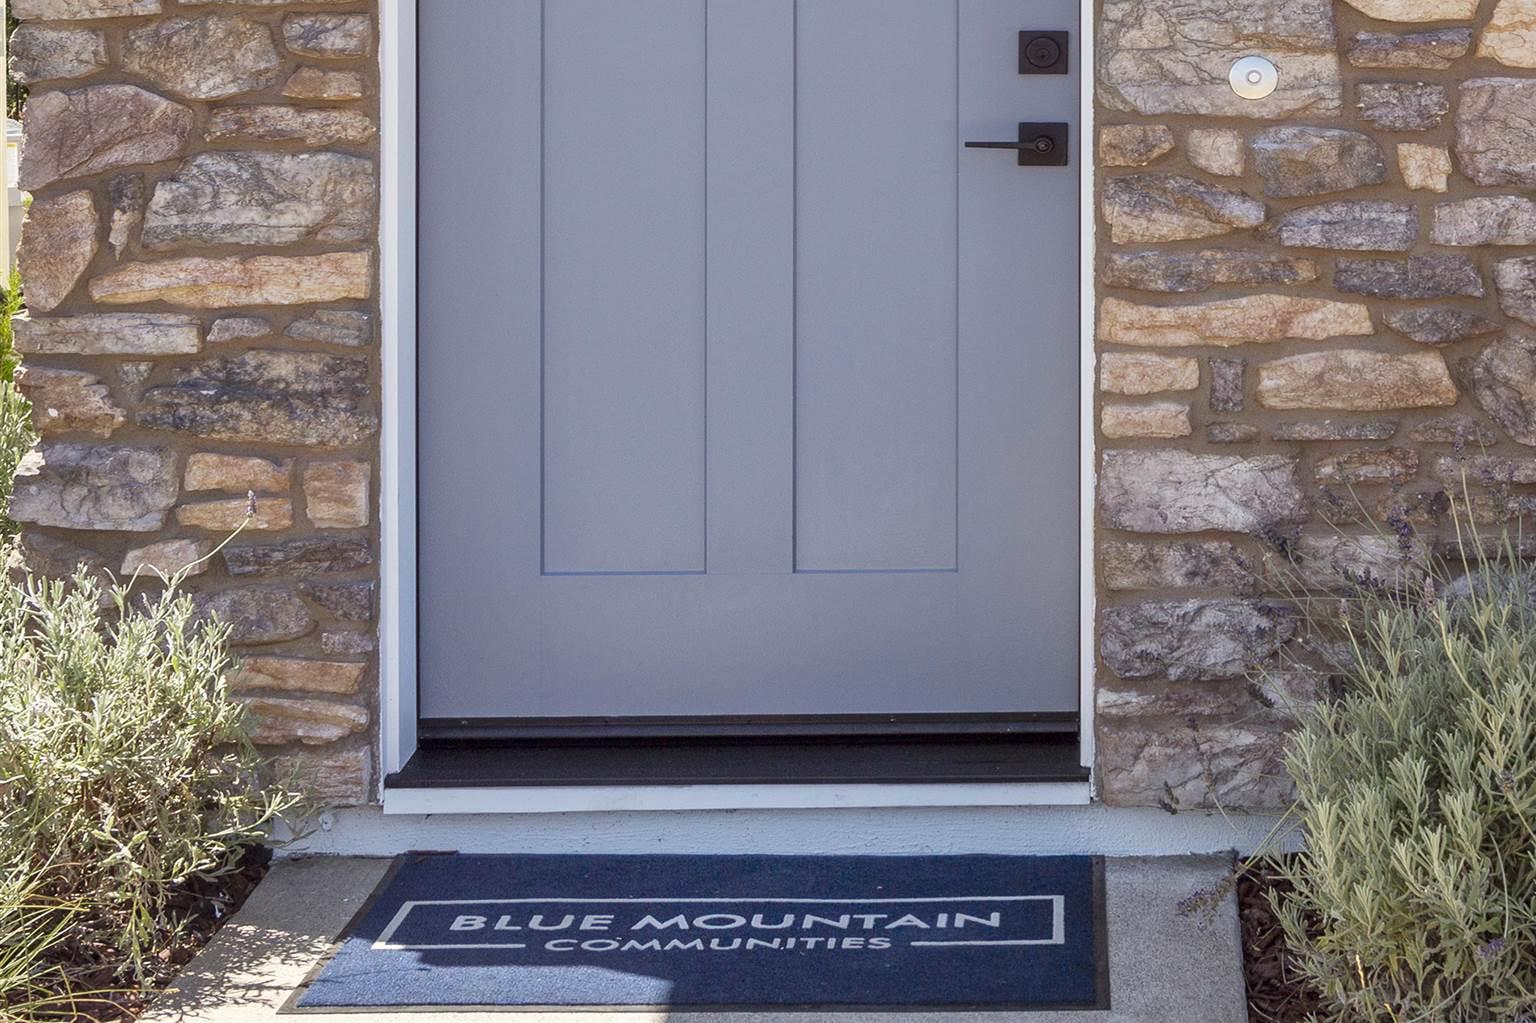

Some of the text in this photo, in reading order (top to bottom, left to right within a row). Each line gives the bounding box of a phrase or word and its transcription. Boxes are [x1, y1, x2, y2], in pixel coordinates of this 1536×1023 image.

[449, 912, 1000, 931] BLUE MOUNTAIN
[544, 937, 892, 951] COMMUNITIES
